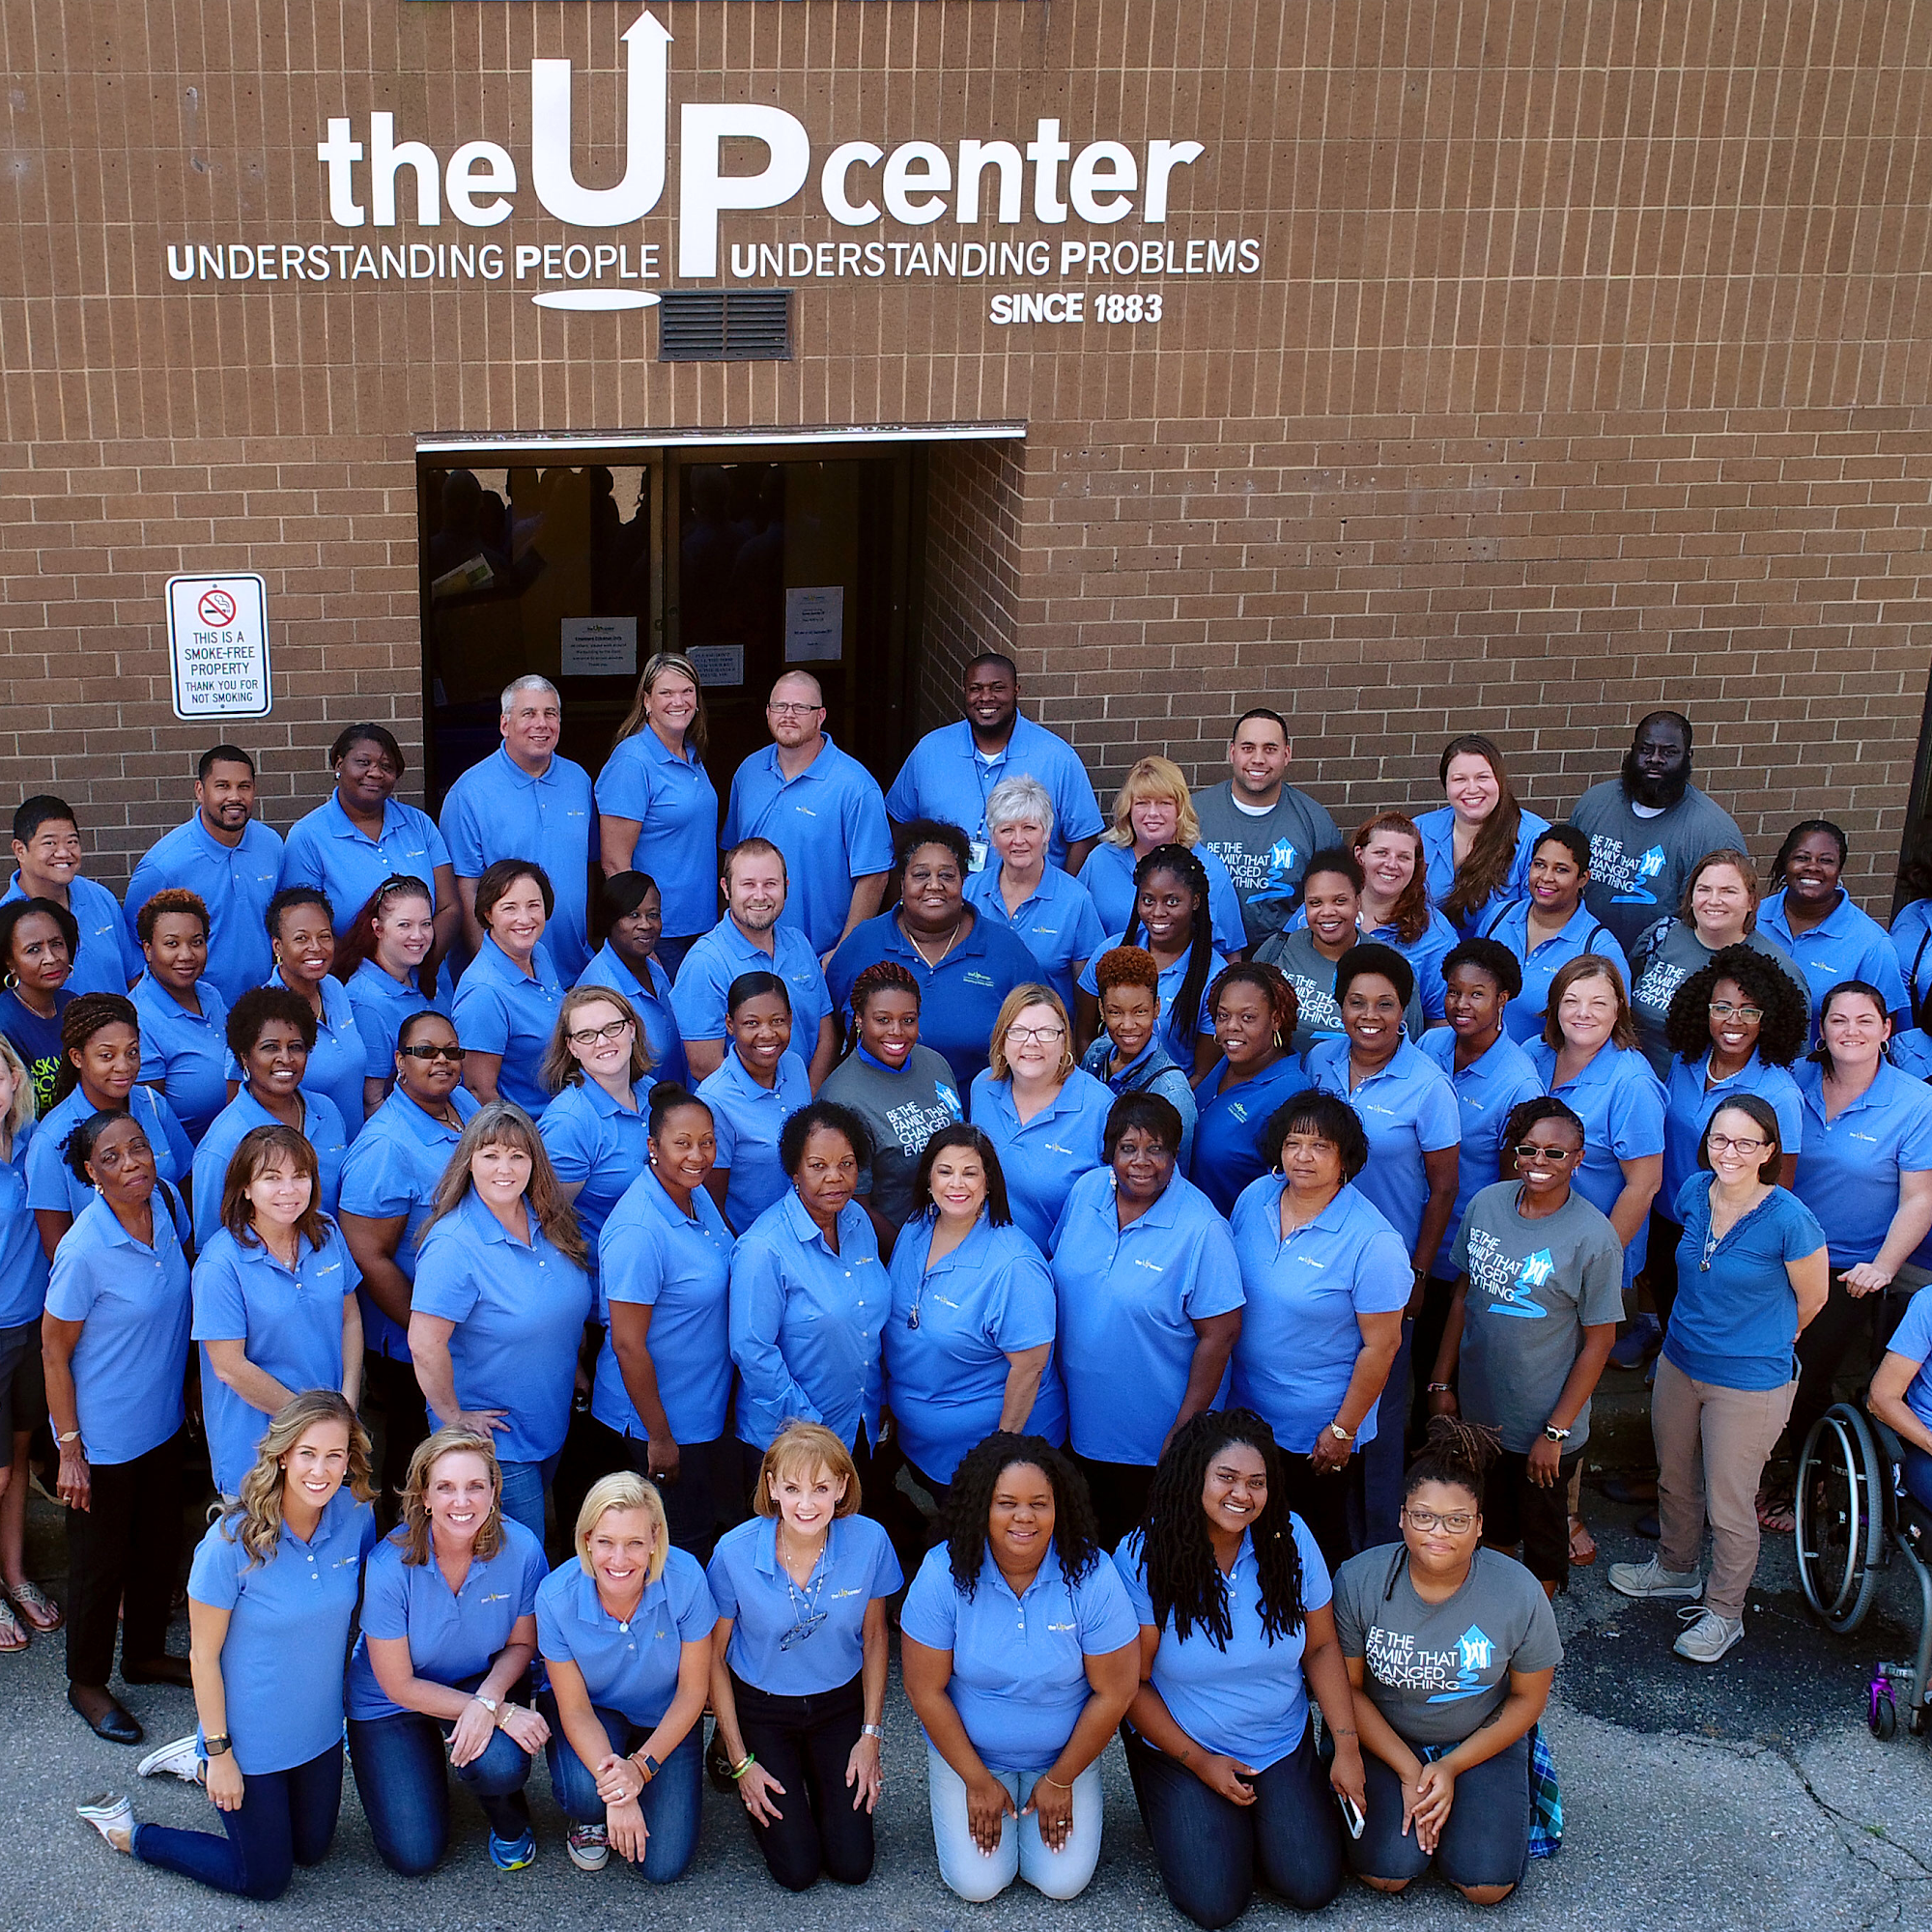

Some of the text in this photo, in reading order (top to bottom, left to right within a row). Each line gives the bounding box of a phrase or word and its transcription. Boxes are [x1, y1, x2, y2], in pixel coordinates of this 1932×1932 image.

[317, 111, 517, 227] the
[821, 118, 1206, 226] center
[167, 240, 1260, 281] UNDERSTANDING PEOPLE UNDERSTANDING PROBLEMS
[989, 293, 1163, 325] SINCE 1883
[193, 631, 244, 644] THIS IS A
[185, 646, 255, 661] SMOKE-FREE
[190, 662, 250, 676] PROPERTY
[185, 679, 259, 692] THANK YOU FOR
[191, 692, 253, 704] NOT SMOKING
[1207, 841, 1243, 854] BE THE
[1590, 834, 1624, 853] BE THE
[1218, 853, 1270, 867] MILY THAT
[1620, 854, 1642, 871] THAT
[1225, 865, 1262, 878] NGED
[1589, 867, 1635, 893] ERYTHING
[1231, 876, 1269, 890] YTHING
[1664, 963, 1687, 980] THE
[1295, 974, 1318, 990] THE
[1296, 995, 1334, 1014] NGED
[1316, 990, 1337, 1005] TH
[1297, 1007, 1342, 1029] THING
[886, 1100, 921, 1123] BE THE
[892, 1101, 950, 1136] FAMILY THAT
[898, 1116, 951, 1145] CHANGED
[1469, 1227, 1501, 1251] BE THE
[1492, 1253, 1523, 1276] THAT
[1468, 1268, 1515, 1302] YTHING
[1386, 1631, 1415, 1651] THE
[1365, 1638, 1459, 1667] FAMILY THAT
[1366, 1653, 1446, 1680] CHANGED
[1371, 1665, 1461, 1690] ERYTHING
